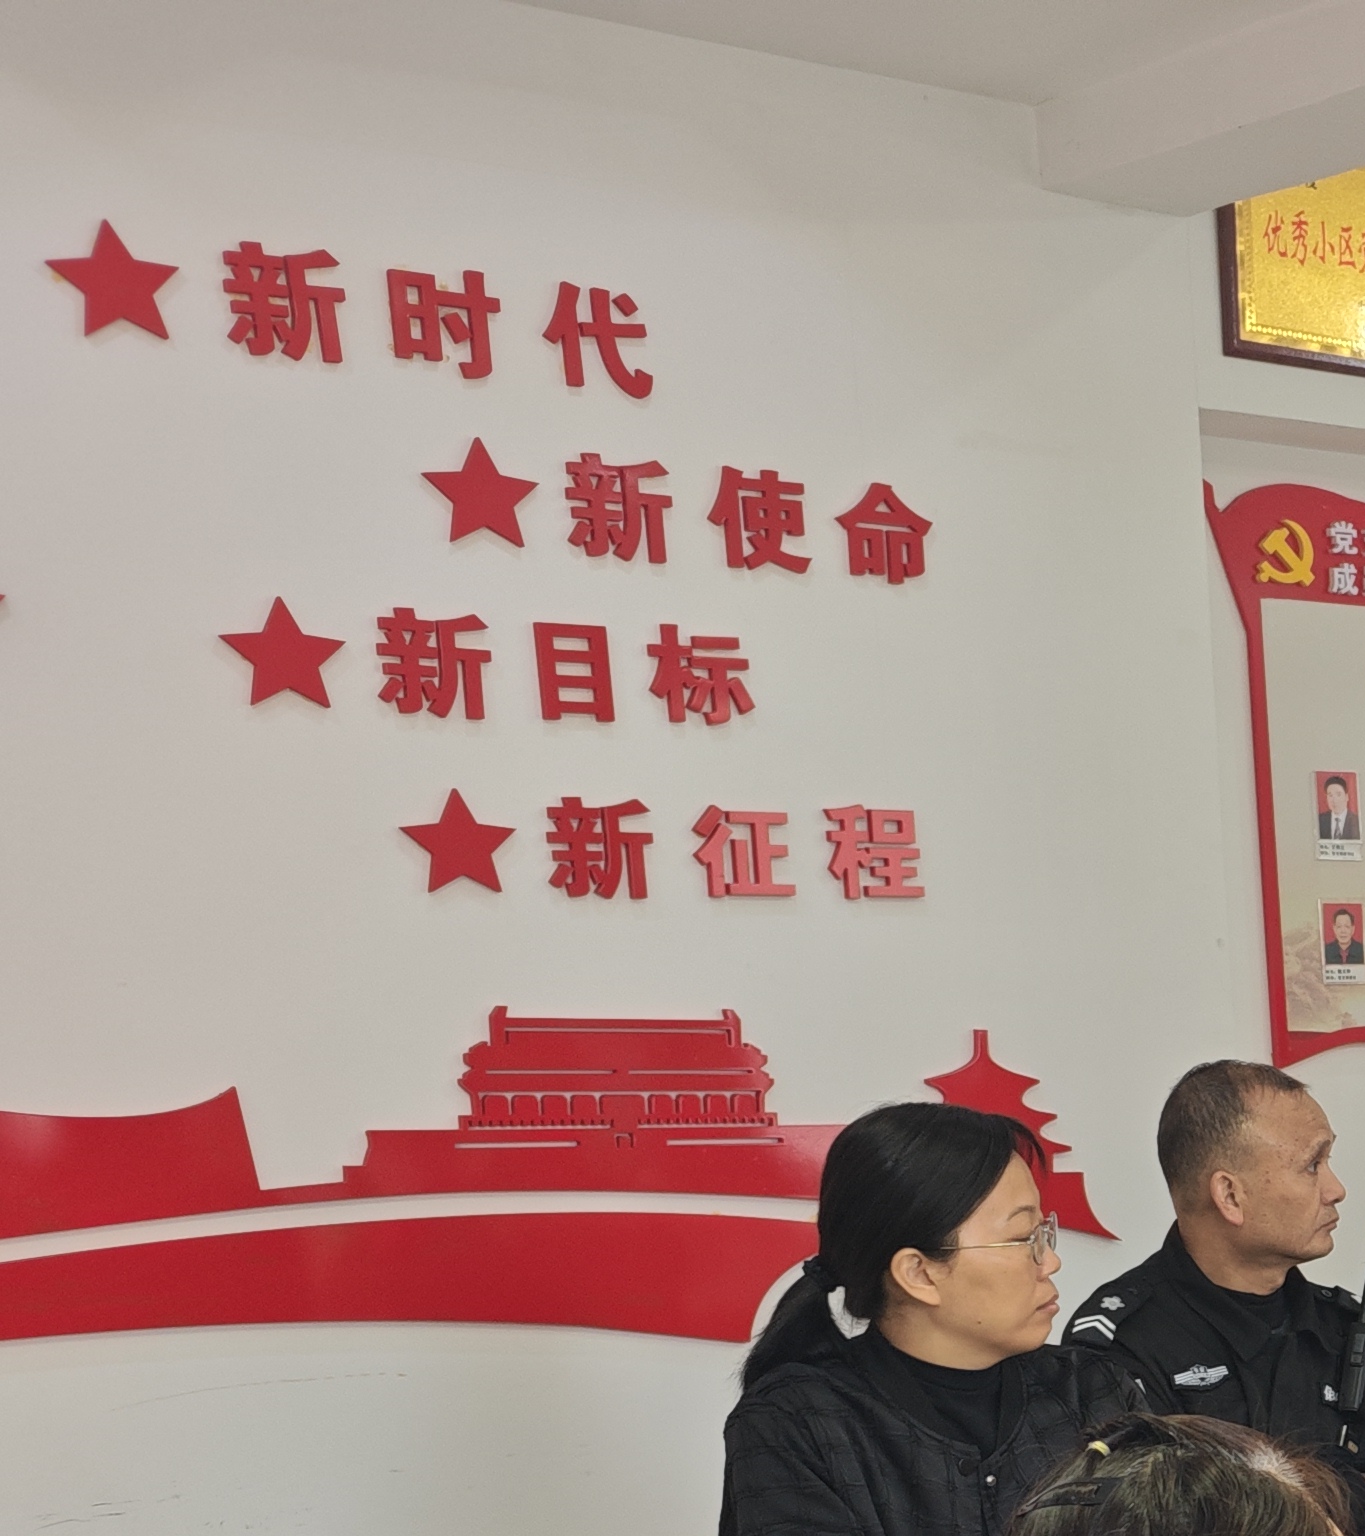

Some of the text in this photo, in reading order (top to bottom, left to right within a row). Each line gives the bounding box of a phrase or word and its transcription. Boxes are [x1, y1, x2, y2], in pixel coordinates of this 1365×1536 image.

[222, 240, 655, 399] 新时代
[565, 452, 934, 585] 新使命
[375, 606, 756, 727] 新目标
[545, 795, 926, 901] 新征程
